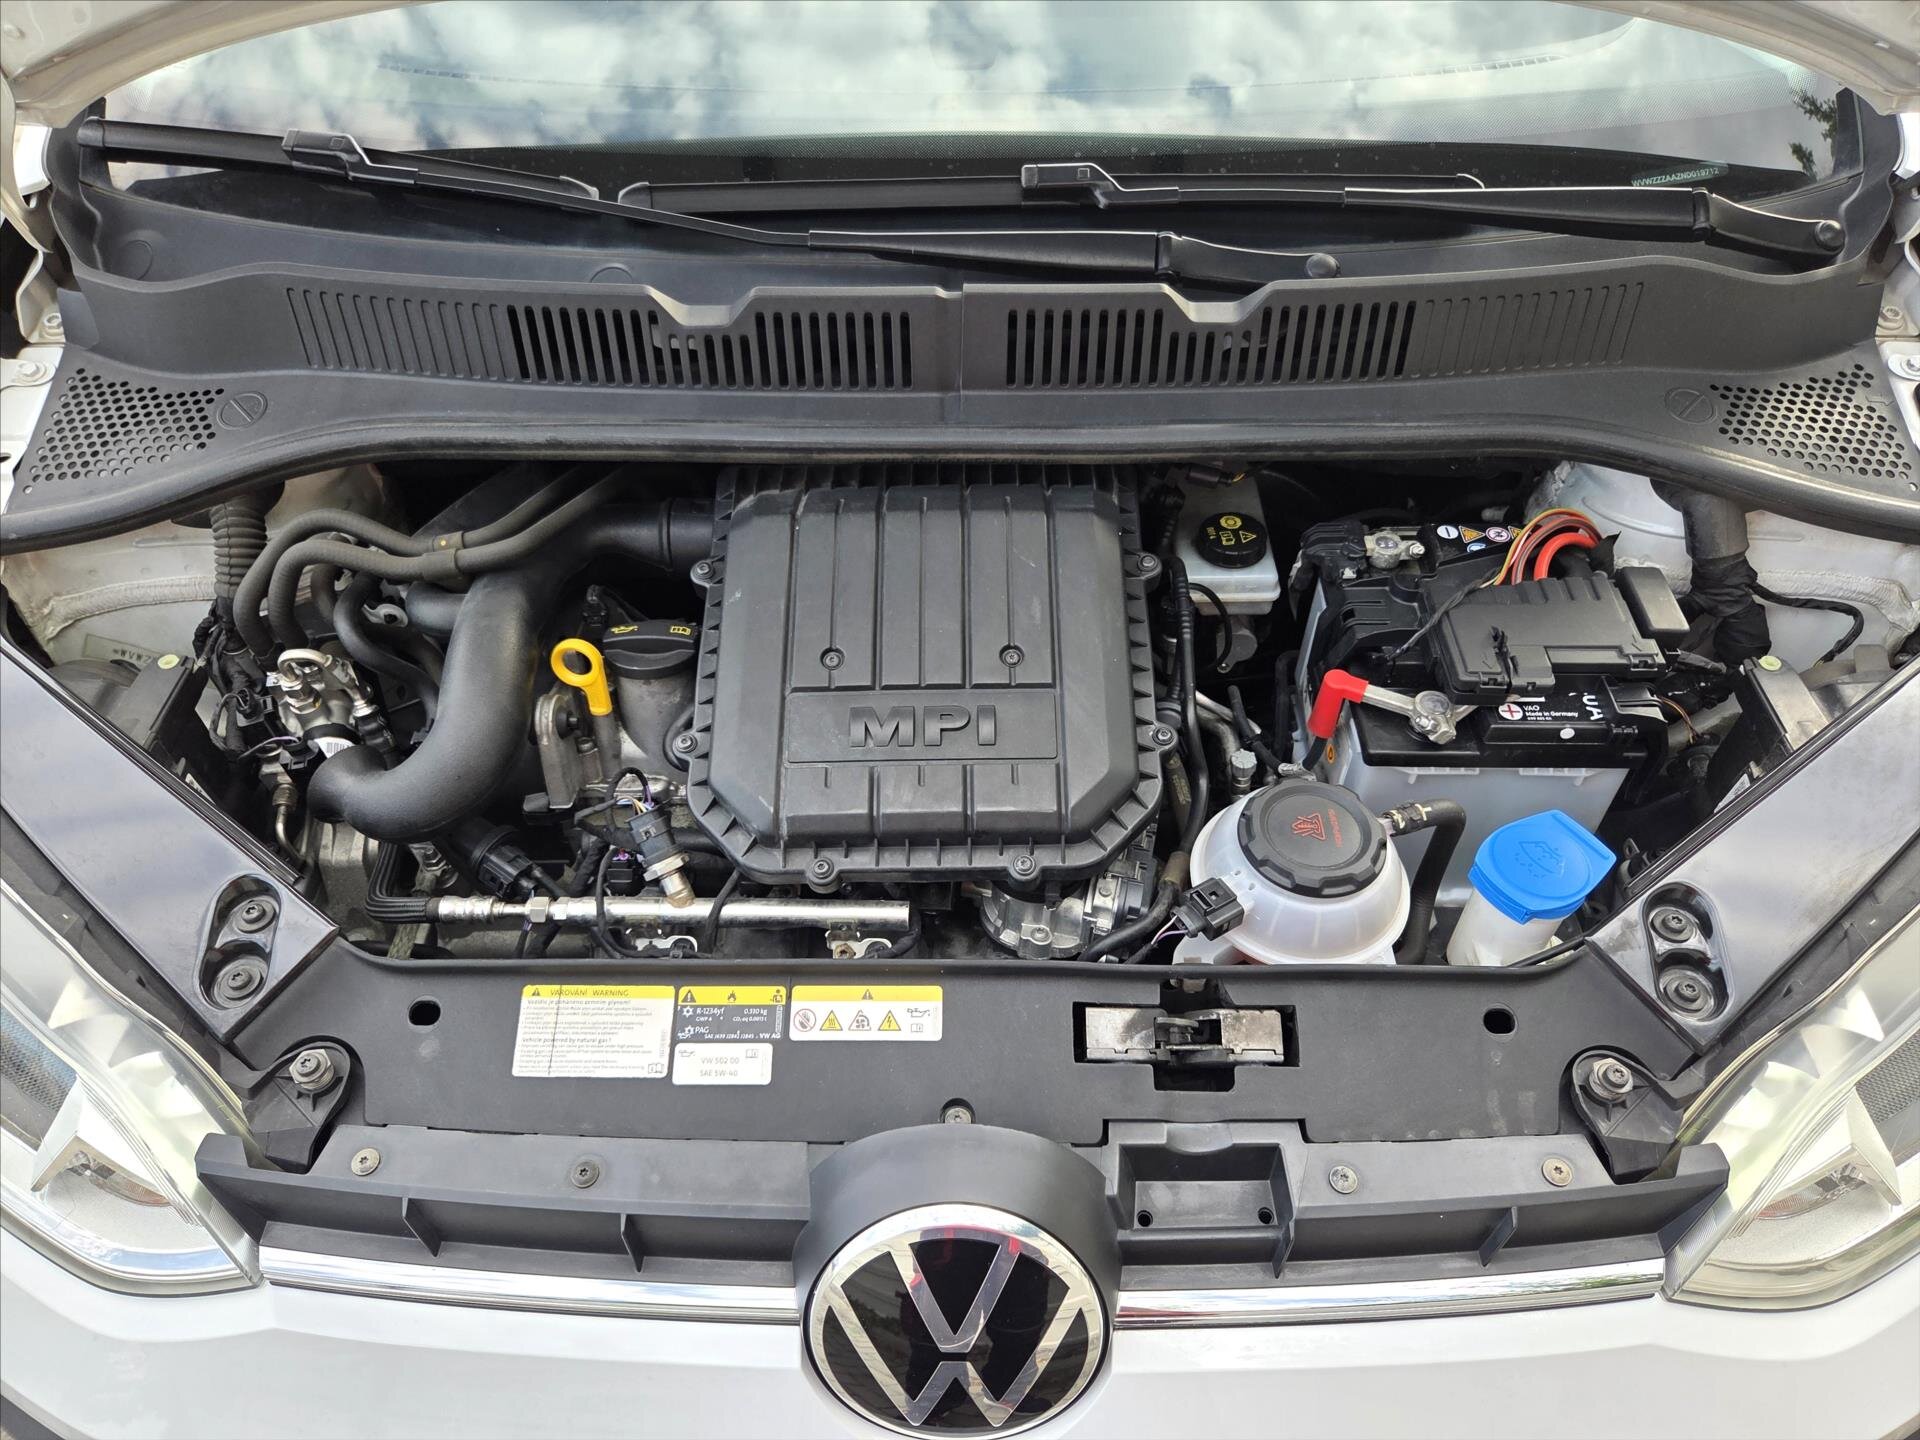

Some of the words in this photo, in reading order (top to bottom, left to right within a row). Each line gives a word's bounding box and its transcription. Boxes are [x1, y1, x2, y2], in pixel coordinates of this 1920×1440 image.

[850, 704, 997, 747] MPI
[592, 989, 629, 997] WARNING
[696, 1007, 725, 1016] R-1234yf
[700, 1069, 713, 1077] SAE
